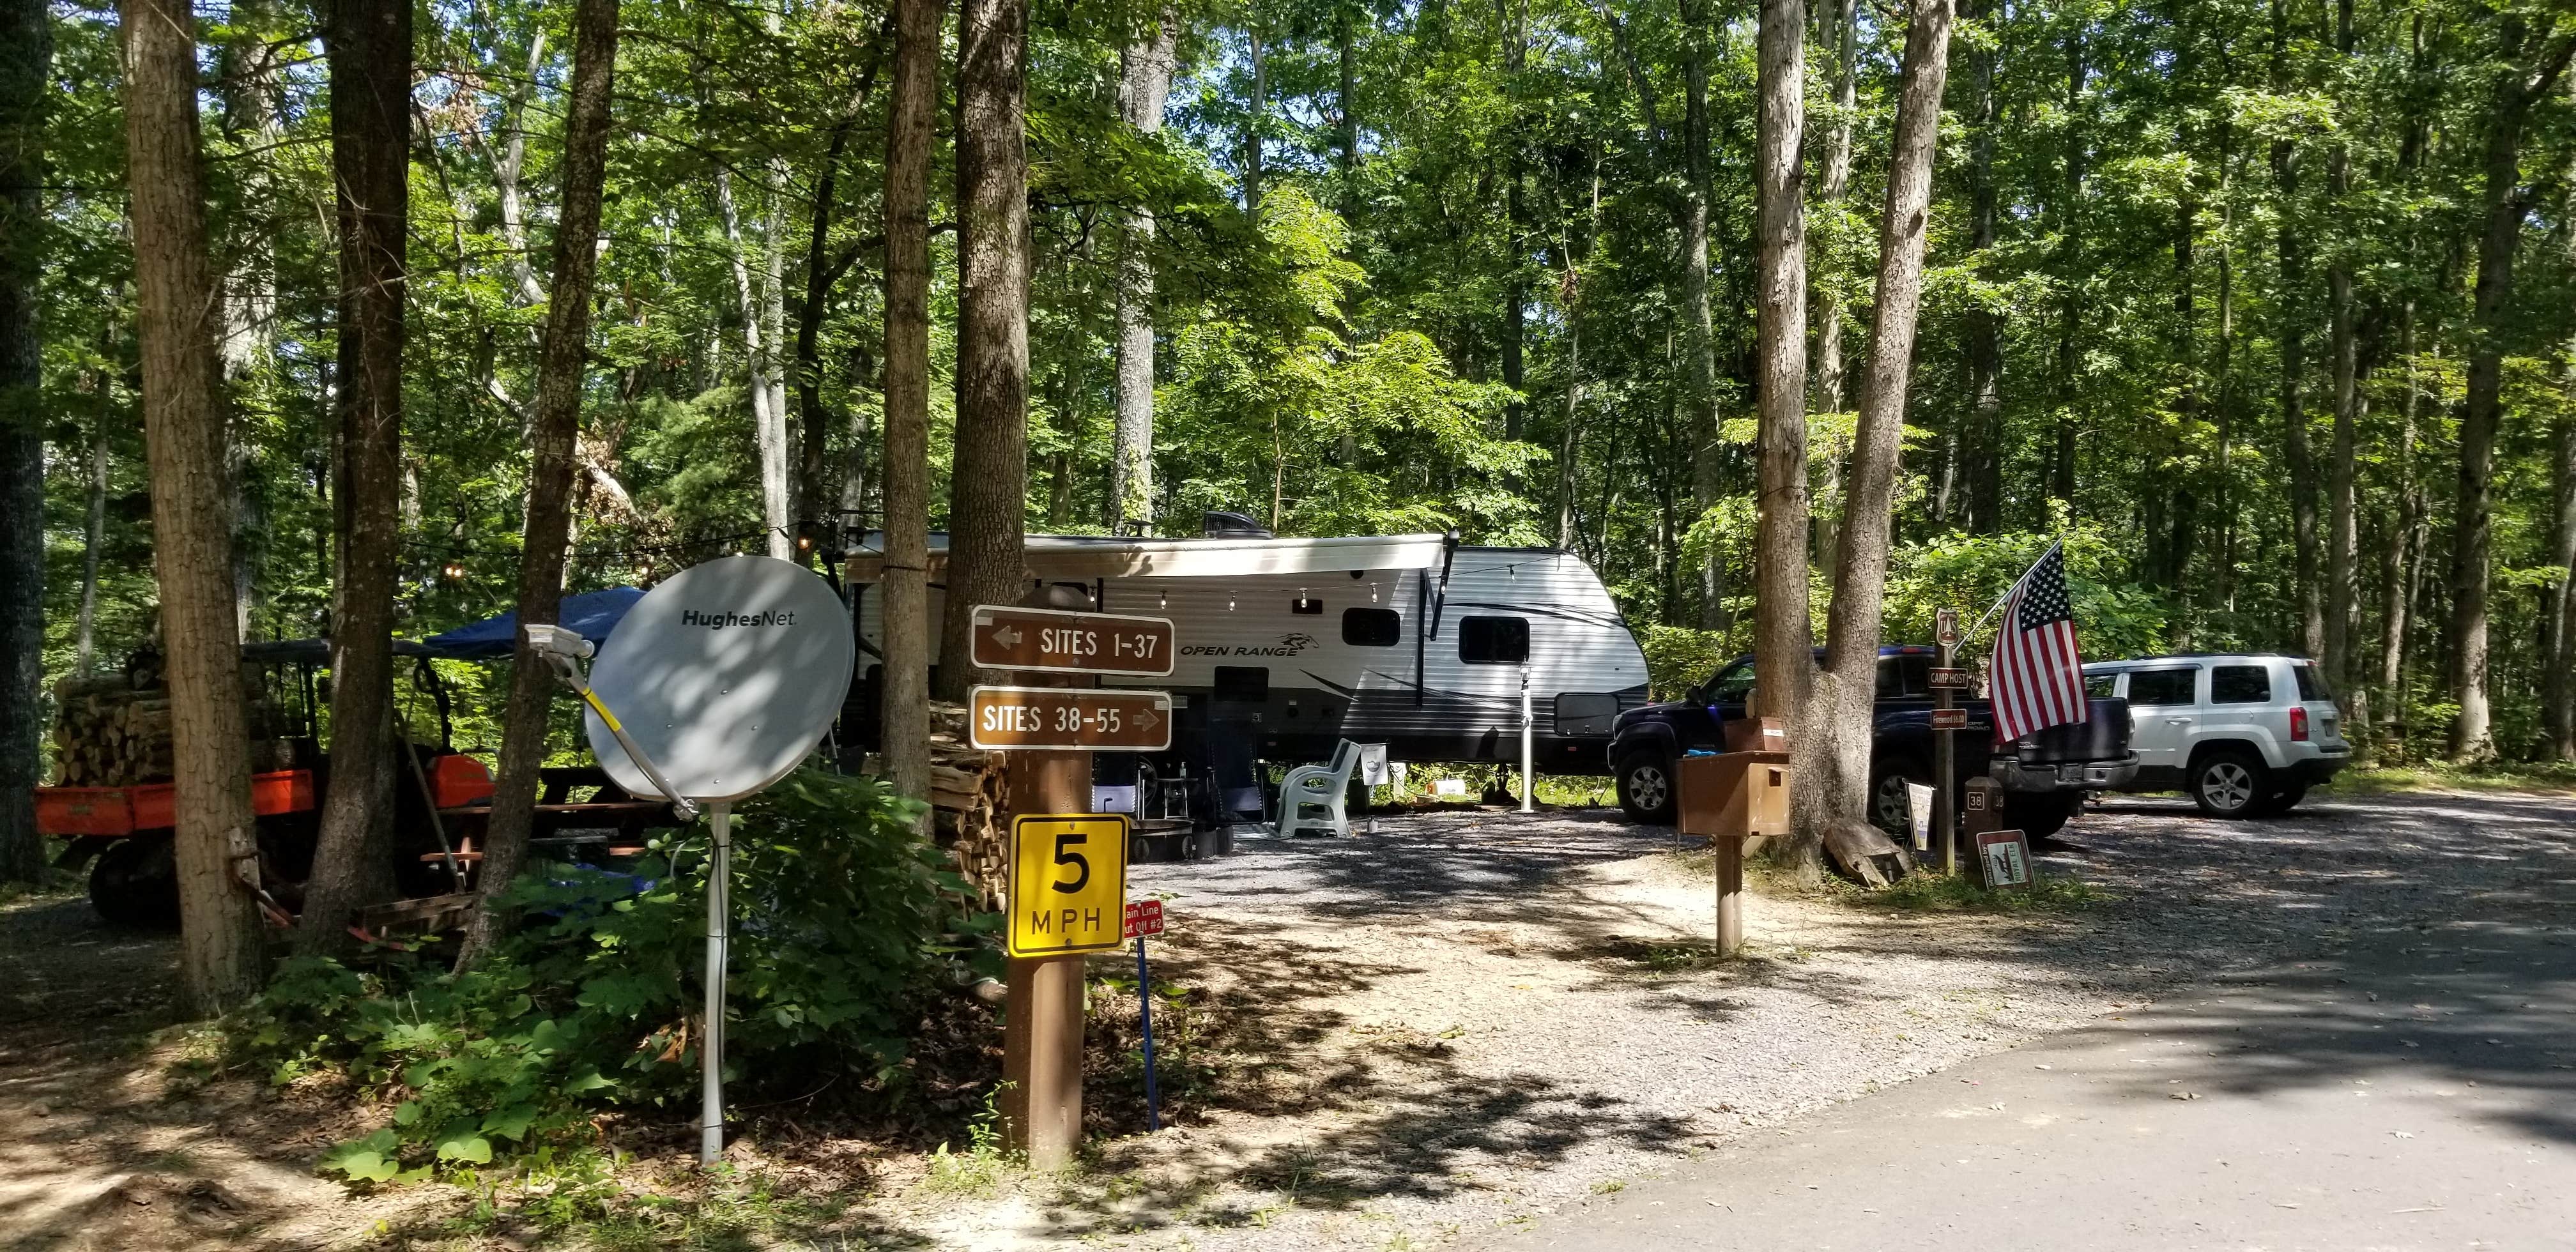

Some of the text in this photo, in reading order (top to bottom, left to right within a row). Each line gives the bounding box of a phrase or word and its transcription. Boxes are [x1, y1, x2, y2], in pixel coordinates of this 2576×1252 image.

[682, 609, 795, 630] HughesNet
[1040, 628, 1158, 659] SITES 1-37
[1180, 646, 1299, 657] OPEN RANGE
[1931, 673, 1966, 684] CAMP HOST
[983, 705, 1121, 733] SITES 38-55
[1933, 715, 1953, 724] Firewood
[1970, 796, 1981, 806] 38
[1052, 833, 1090, 894] 5
[1984, 855, 1994, 886] Managed
[2009, 844, 2021, 881] ROYAL ELK
[1032, 907, 1100, 935] MPH
[1126, 906, 1159, 919] ain Line
[1136, 920, 1147, 931] Off
[1150, 919, 1162, 929] #2
